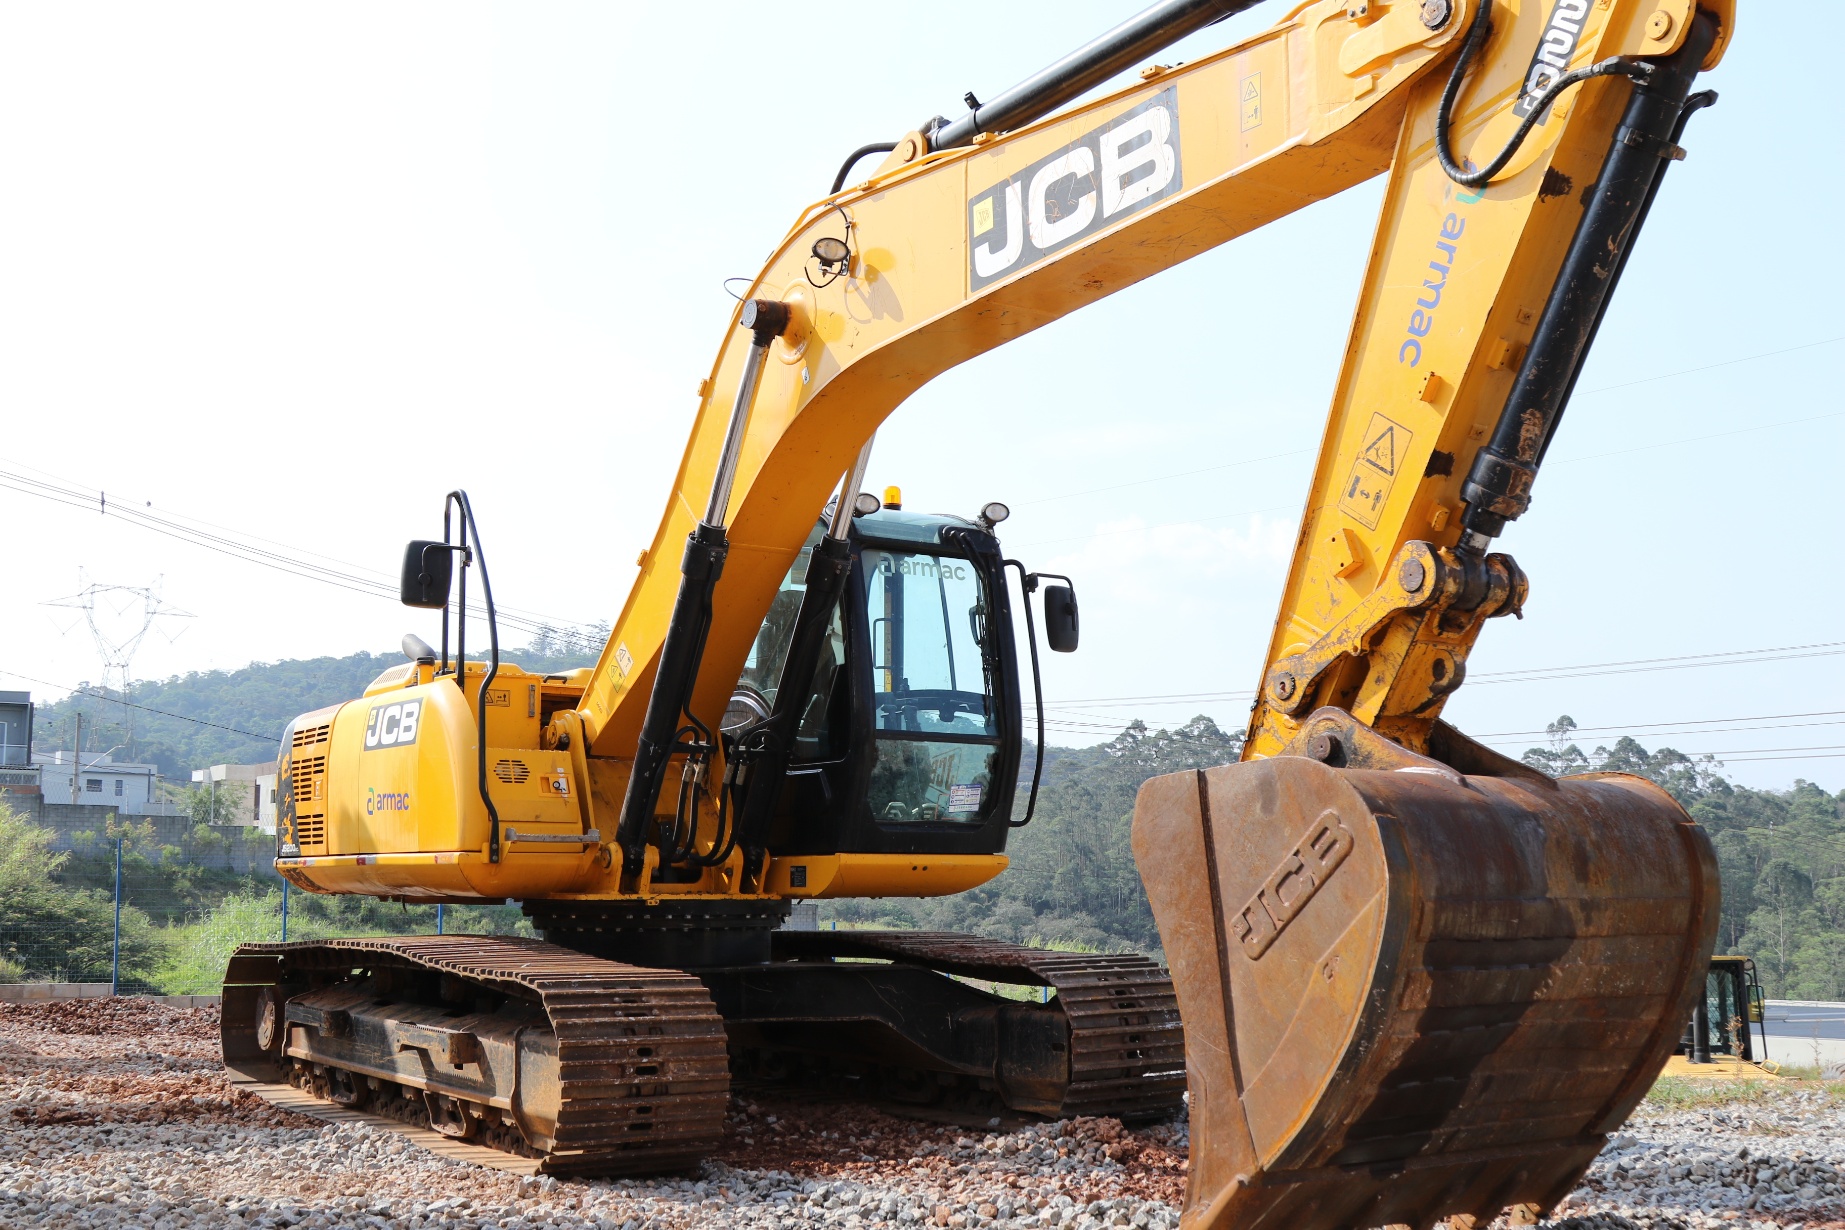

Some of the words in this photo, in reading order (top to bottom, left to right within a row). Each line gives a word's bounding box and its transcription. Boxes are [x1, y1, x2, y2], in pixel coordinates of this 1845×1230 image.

[974, 106, 1176, 278] JCB
[1398, 212, 1467, 368] armac
[899, 560, 966, 580] armac
[366, 702, 420, 747] JCB
[376, 792, 409, 811] armac
[1230, 809, 1354, 961] JCB
